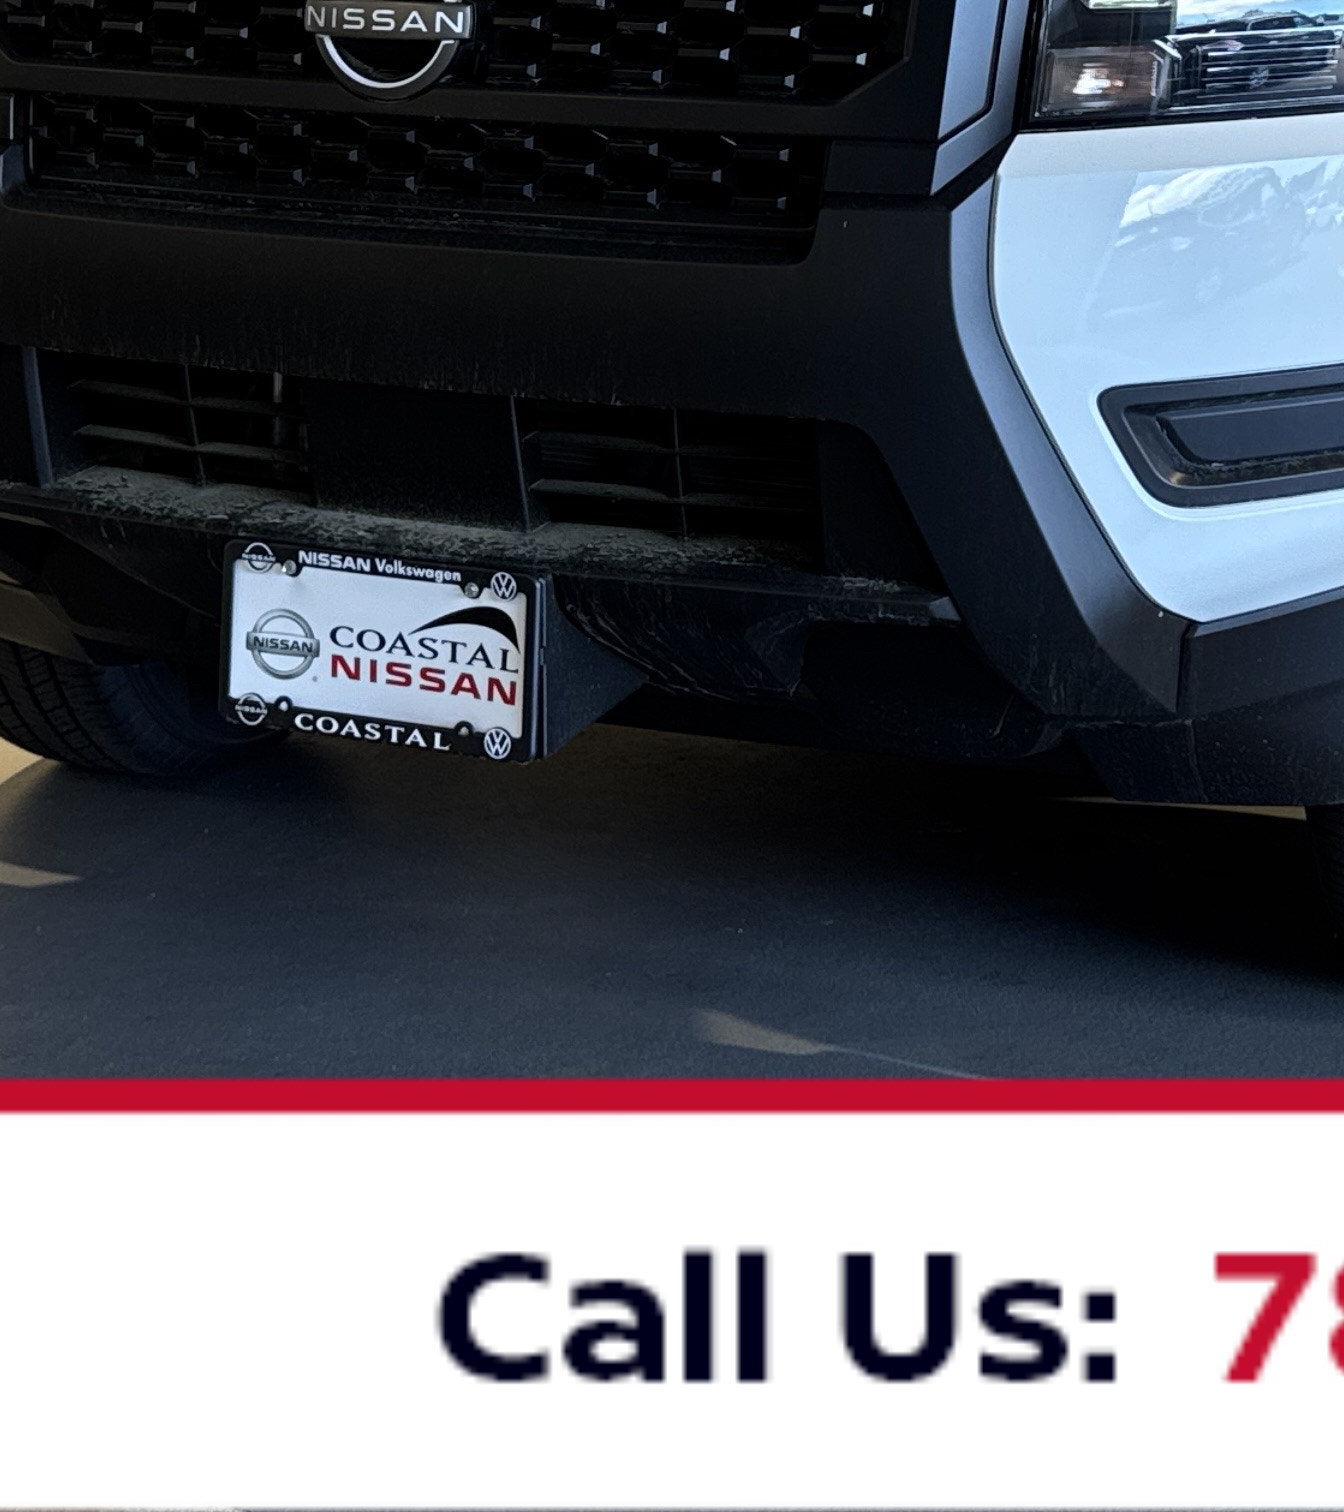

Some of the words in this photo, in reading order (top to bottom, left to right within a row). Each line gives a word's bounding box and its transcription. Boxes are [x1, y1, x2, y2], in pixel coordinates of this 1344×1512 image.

[307, 5, 464, 33] NISSAN
[298, 550, 371, 573] NISSAN
[374, 559, 462, 583] Volkswagen
[253, 635, 315, 654] NISSAN
[329, 625, 519, 675] COASTAL
[330, 653, 517, 706] NISSAN
[294, 713, 452, 752] COASTAL
